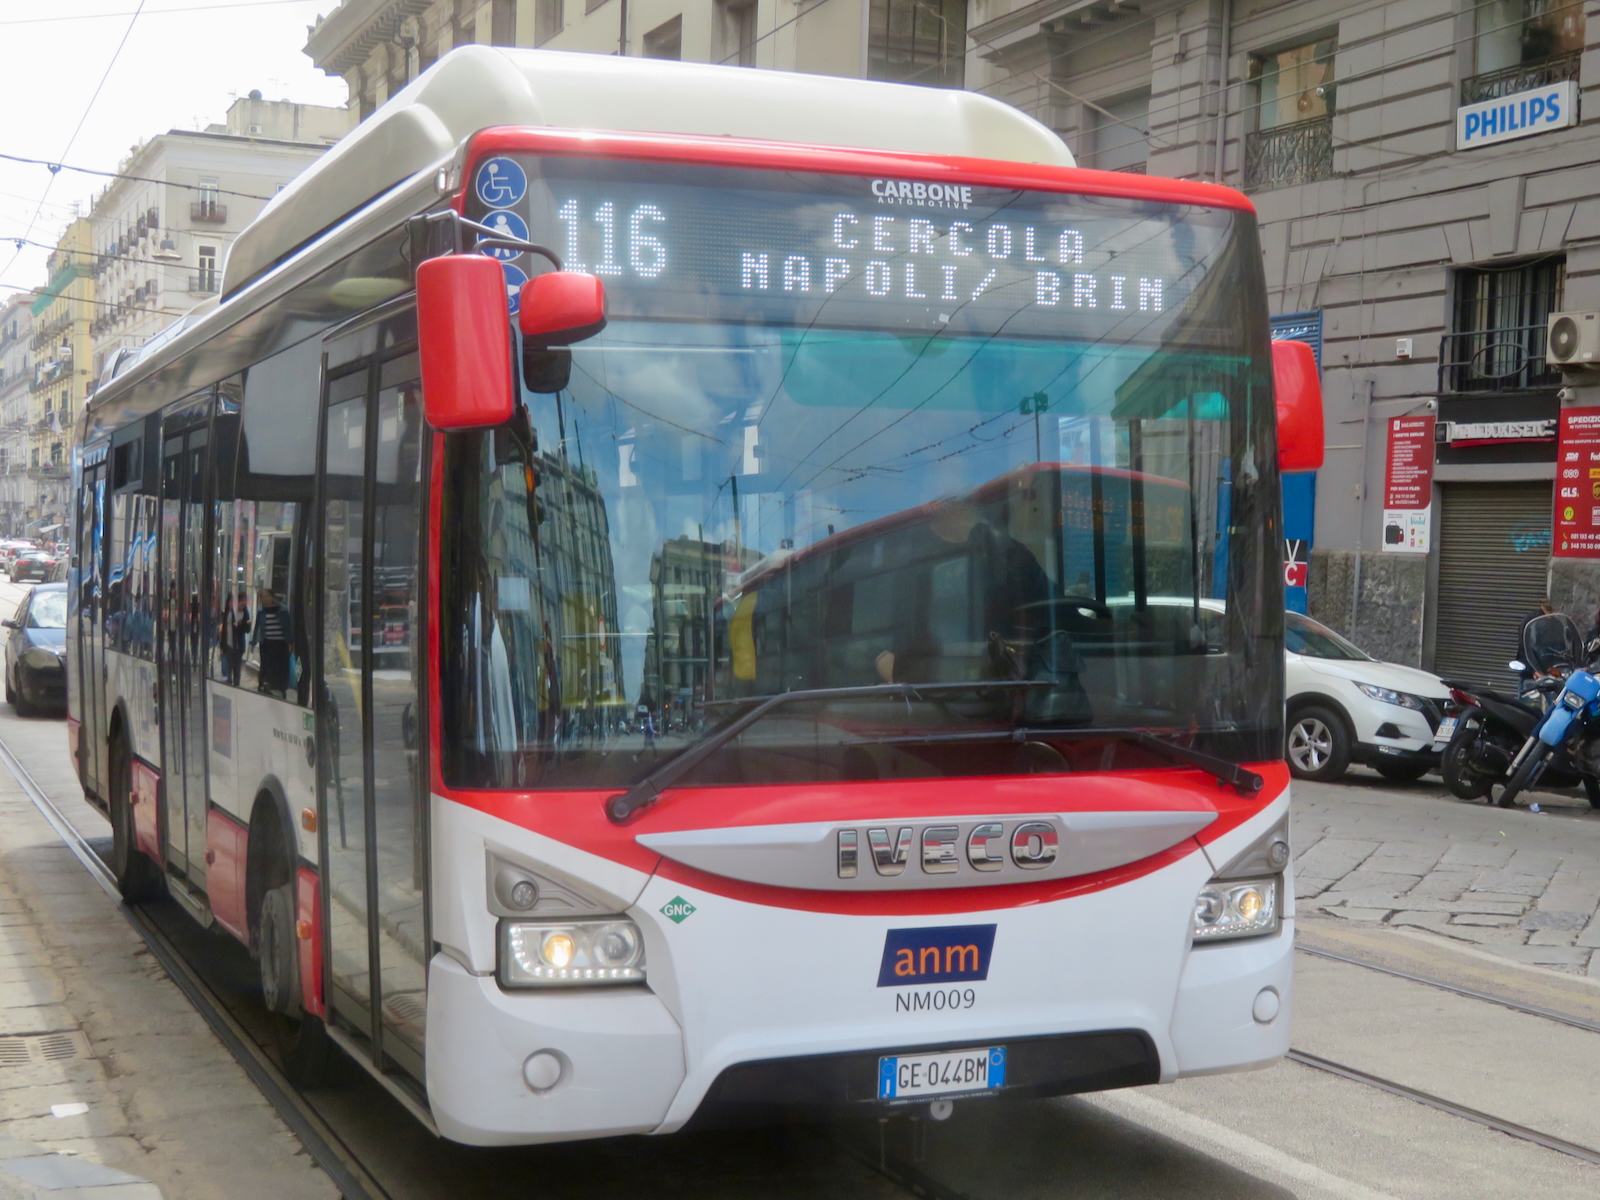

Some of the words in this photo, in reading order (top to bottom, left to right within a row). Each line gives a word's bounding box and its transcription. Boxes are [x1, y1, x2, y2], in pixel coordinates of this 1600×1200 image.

[1465, 93, 1560, 140] PHILIPS
[871, 179, 973, 203] CARBONE
[877, 196, 969, 210] AUTOMOTIVE
[558, 199, 667, 278] 116
[832, 212, 1085, 265] CERCOLA
[837, 820, 1059, 880] IVECO
[664, 903, 692, 916] GNC
[895, 943, 980, 977] anm
[895, 988, 976, 1013] NM009
